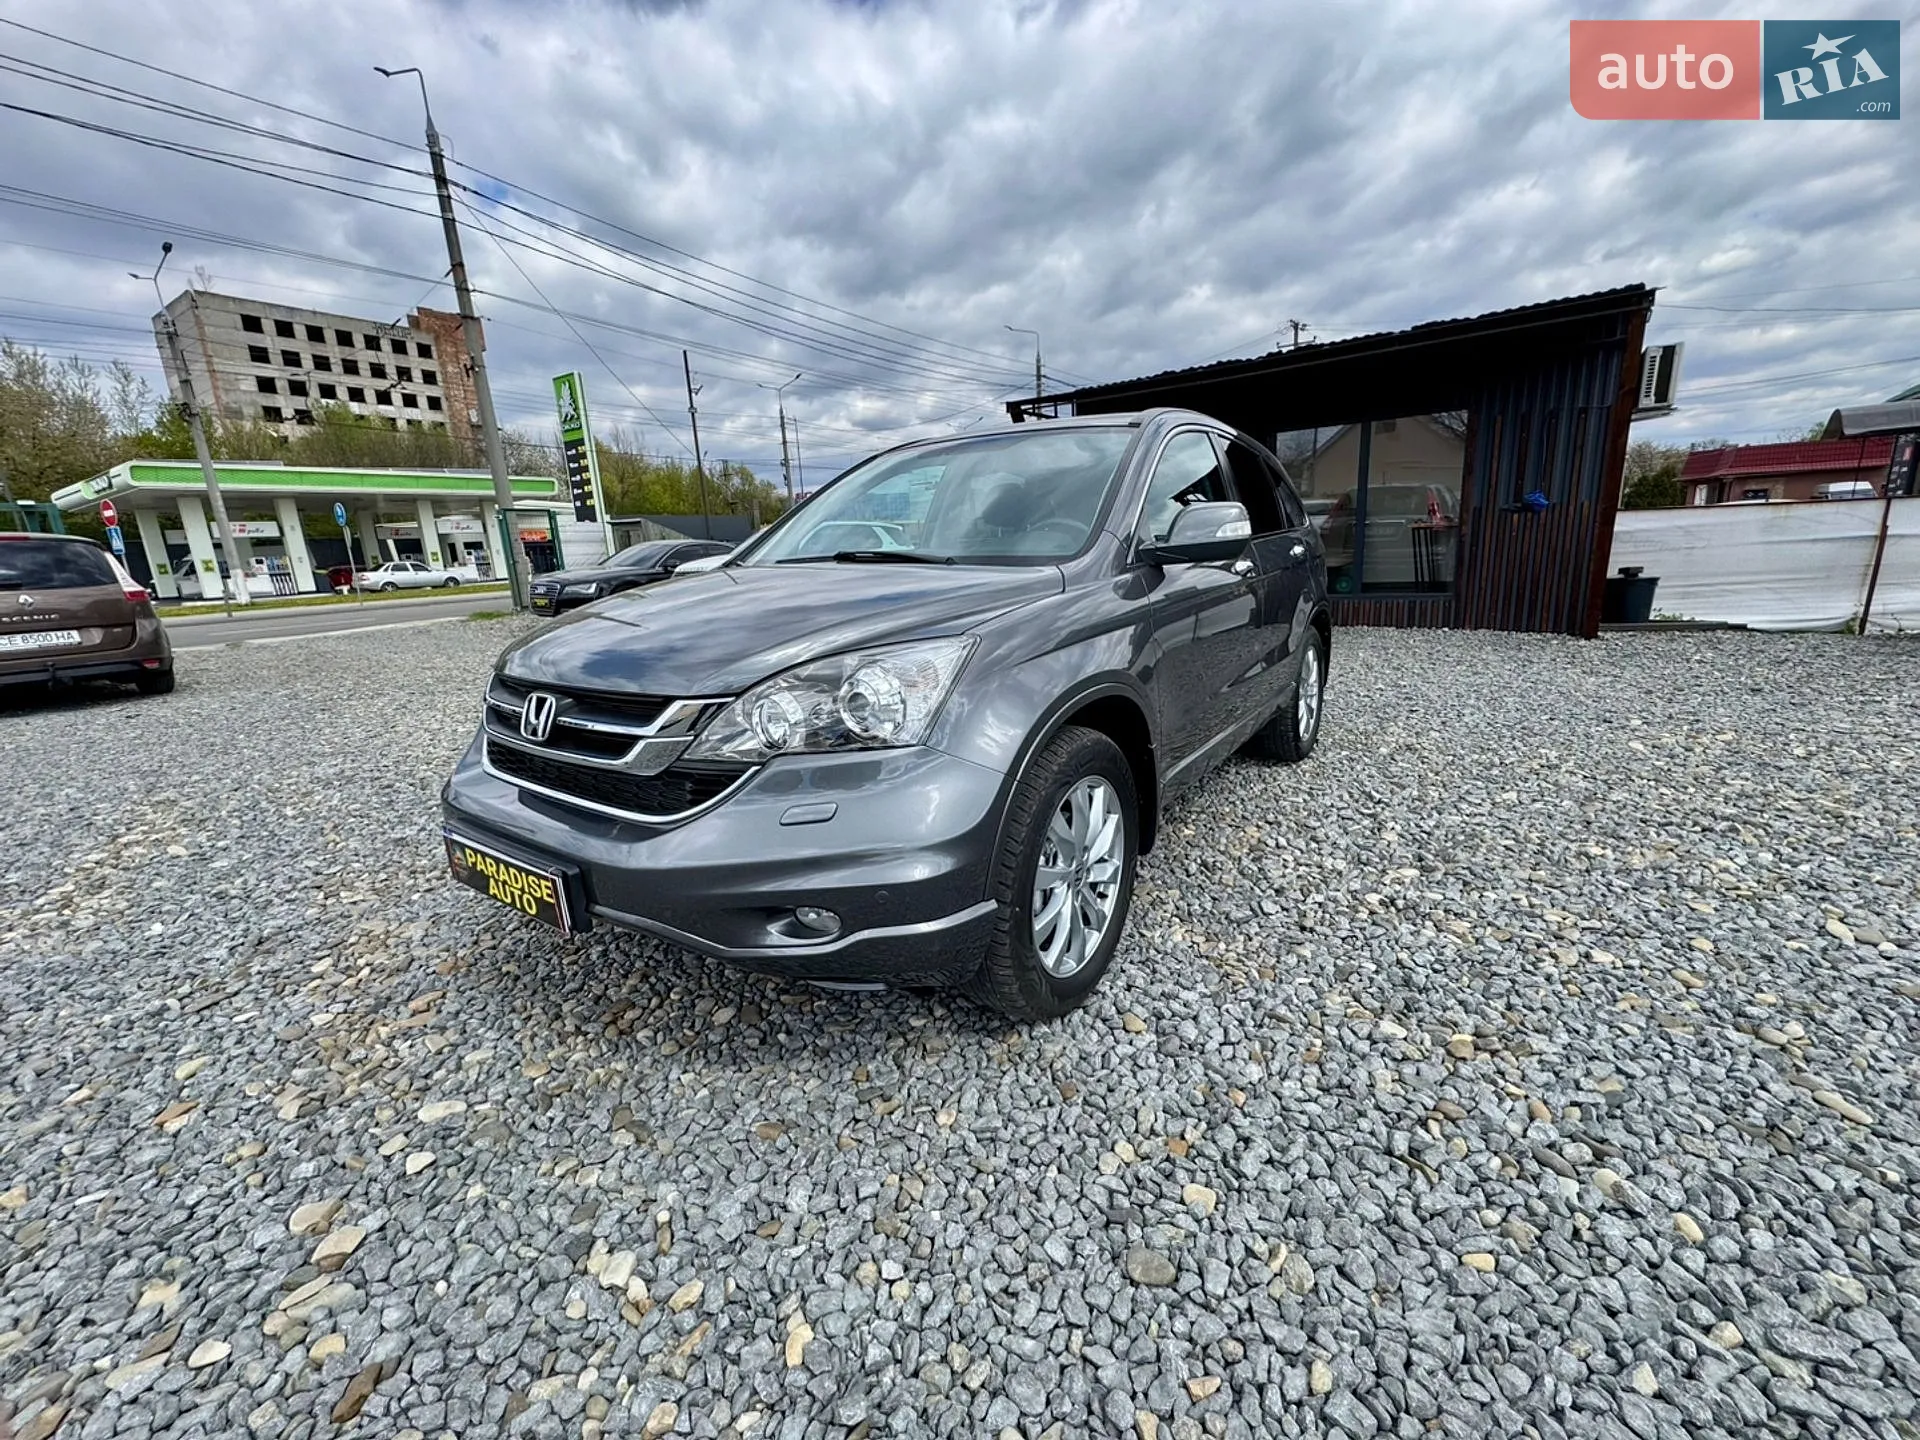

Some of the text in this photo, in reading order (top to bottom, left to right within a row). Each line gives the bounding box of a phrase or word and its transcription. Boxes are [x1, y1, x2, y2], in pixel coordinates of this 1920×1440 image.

[21, 633, 53, 644] 8500
[54, 631, 75, 642] HA
[465, 848, 555, 904] PARADISE
[488, 877, 537, 915] AUTO
